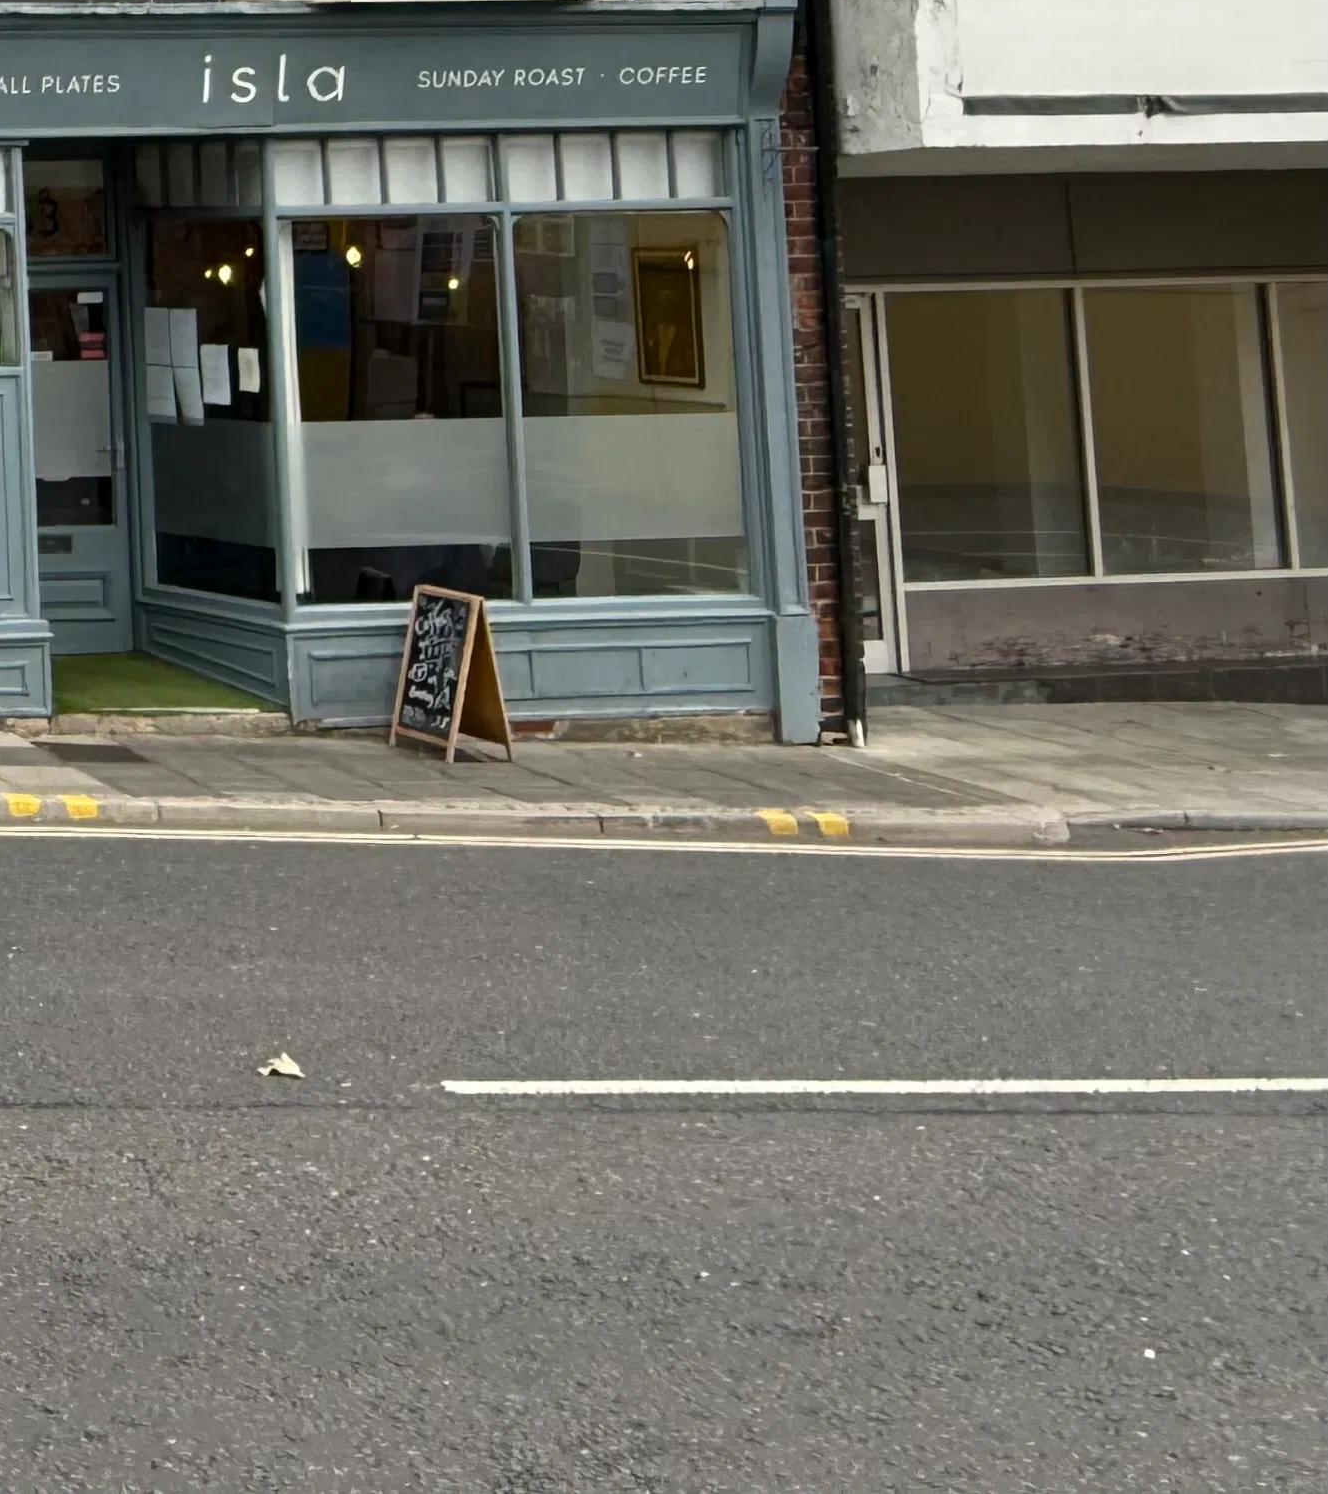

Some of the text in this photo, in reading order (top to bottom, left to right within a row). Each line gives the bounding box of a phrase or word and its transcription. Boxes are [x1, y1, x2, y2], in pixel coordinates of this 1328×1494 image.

[41, 74, 121, 94] PLATES
[202, 53, 346, 104] isla
[416, 67, 586, 89] SUNDAY ROAST
[618, 65, 708, 86] COFFEE
